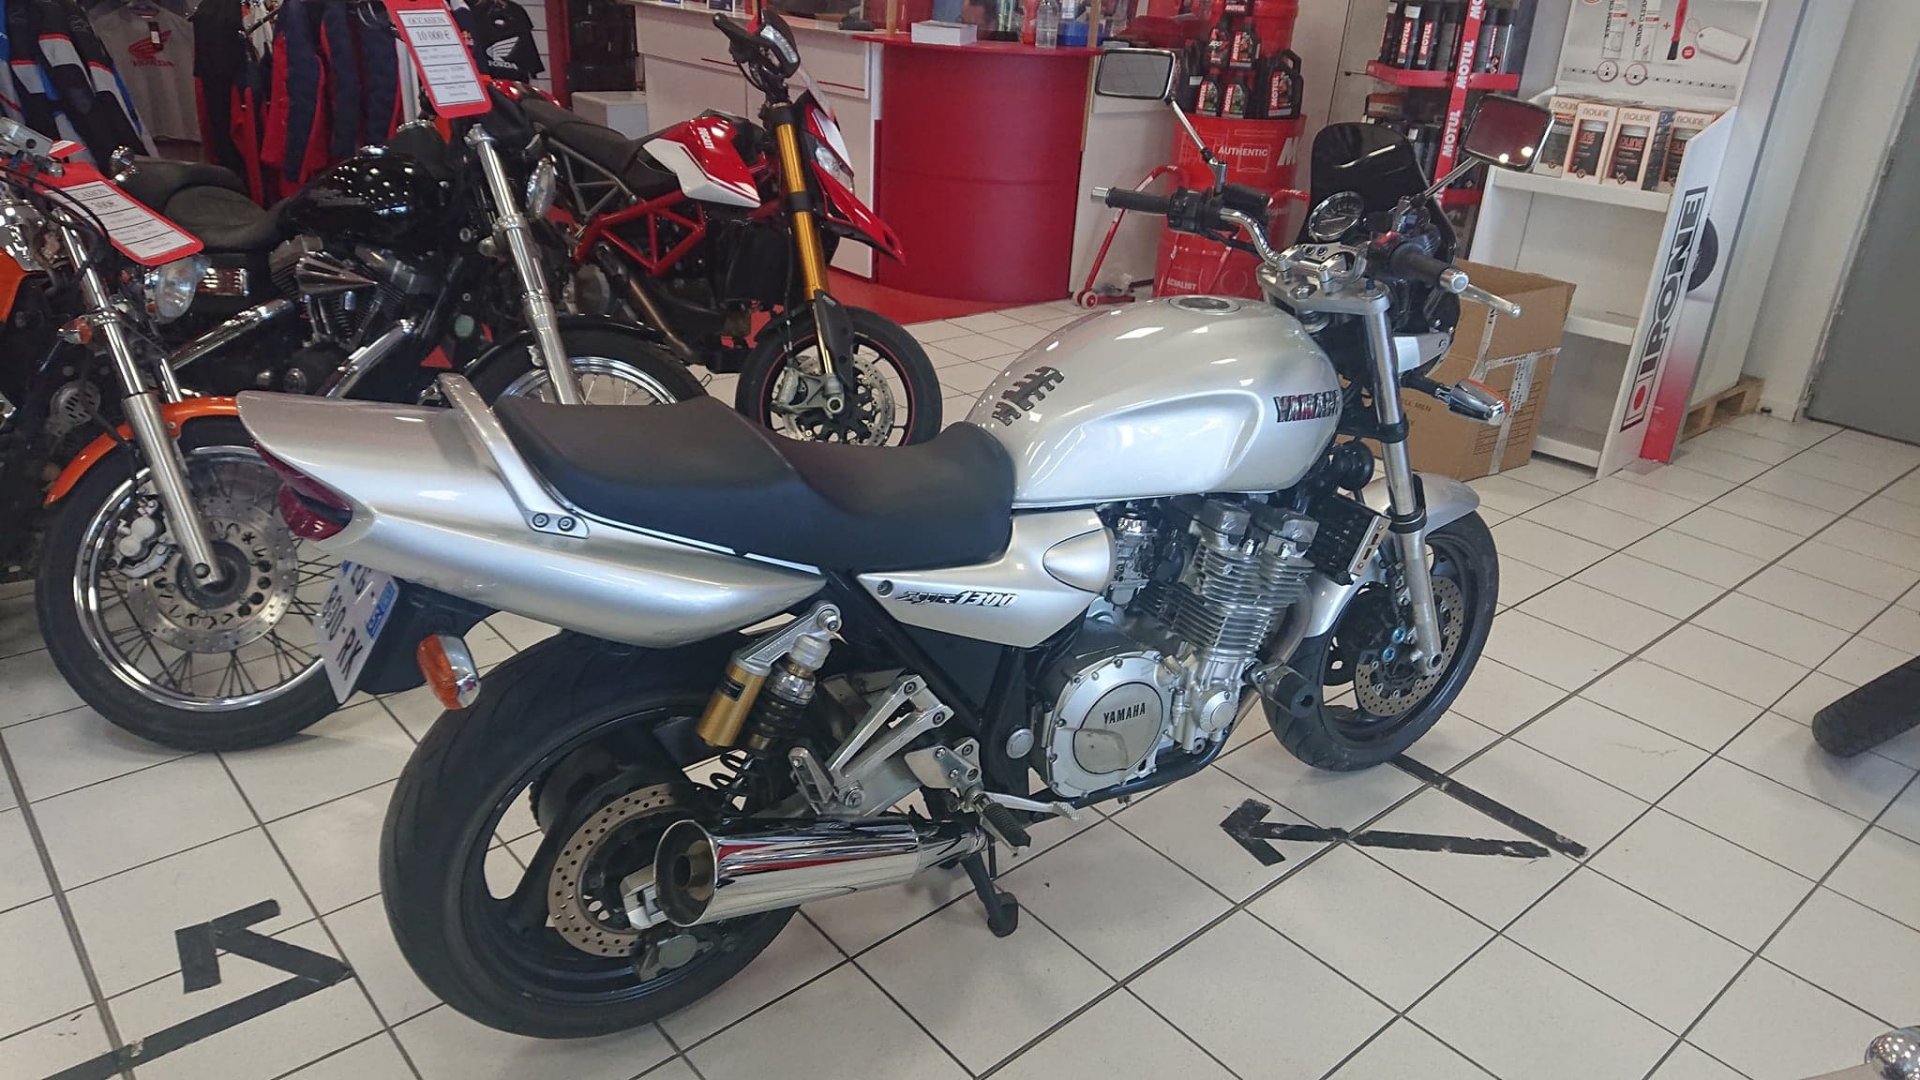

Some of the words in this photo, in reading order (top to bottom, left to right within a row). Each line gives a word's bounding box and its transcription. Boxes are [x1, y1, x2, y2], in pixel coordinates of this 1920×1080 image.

[1400, 22, 1412, 53] MOTUL
[1421, 23, 1433, 55] MOTUL
[1456, 40, 1475, 89] MOTUL
[1271, 76, 1280, 107] MOTUL
[1442, 110, 1462, 157] MOTUL
[1218, 146, 1268, 157] AUTHENTIC
[1640, 197, 1702, 376] IPONE
[1103, 702, 1146, 725] YAMAHA
